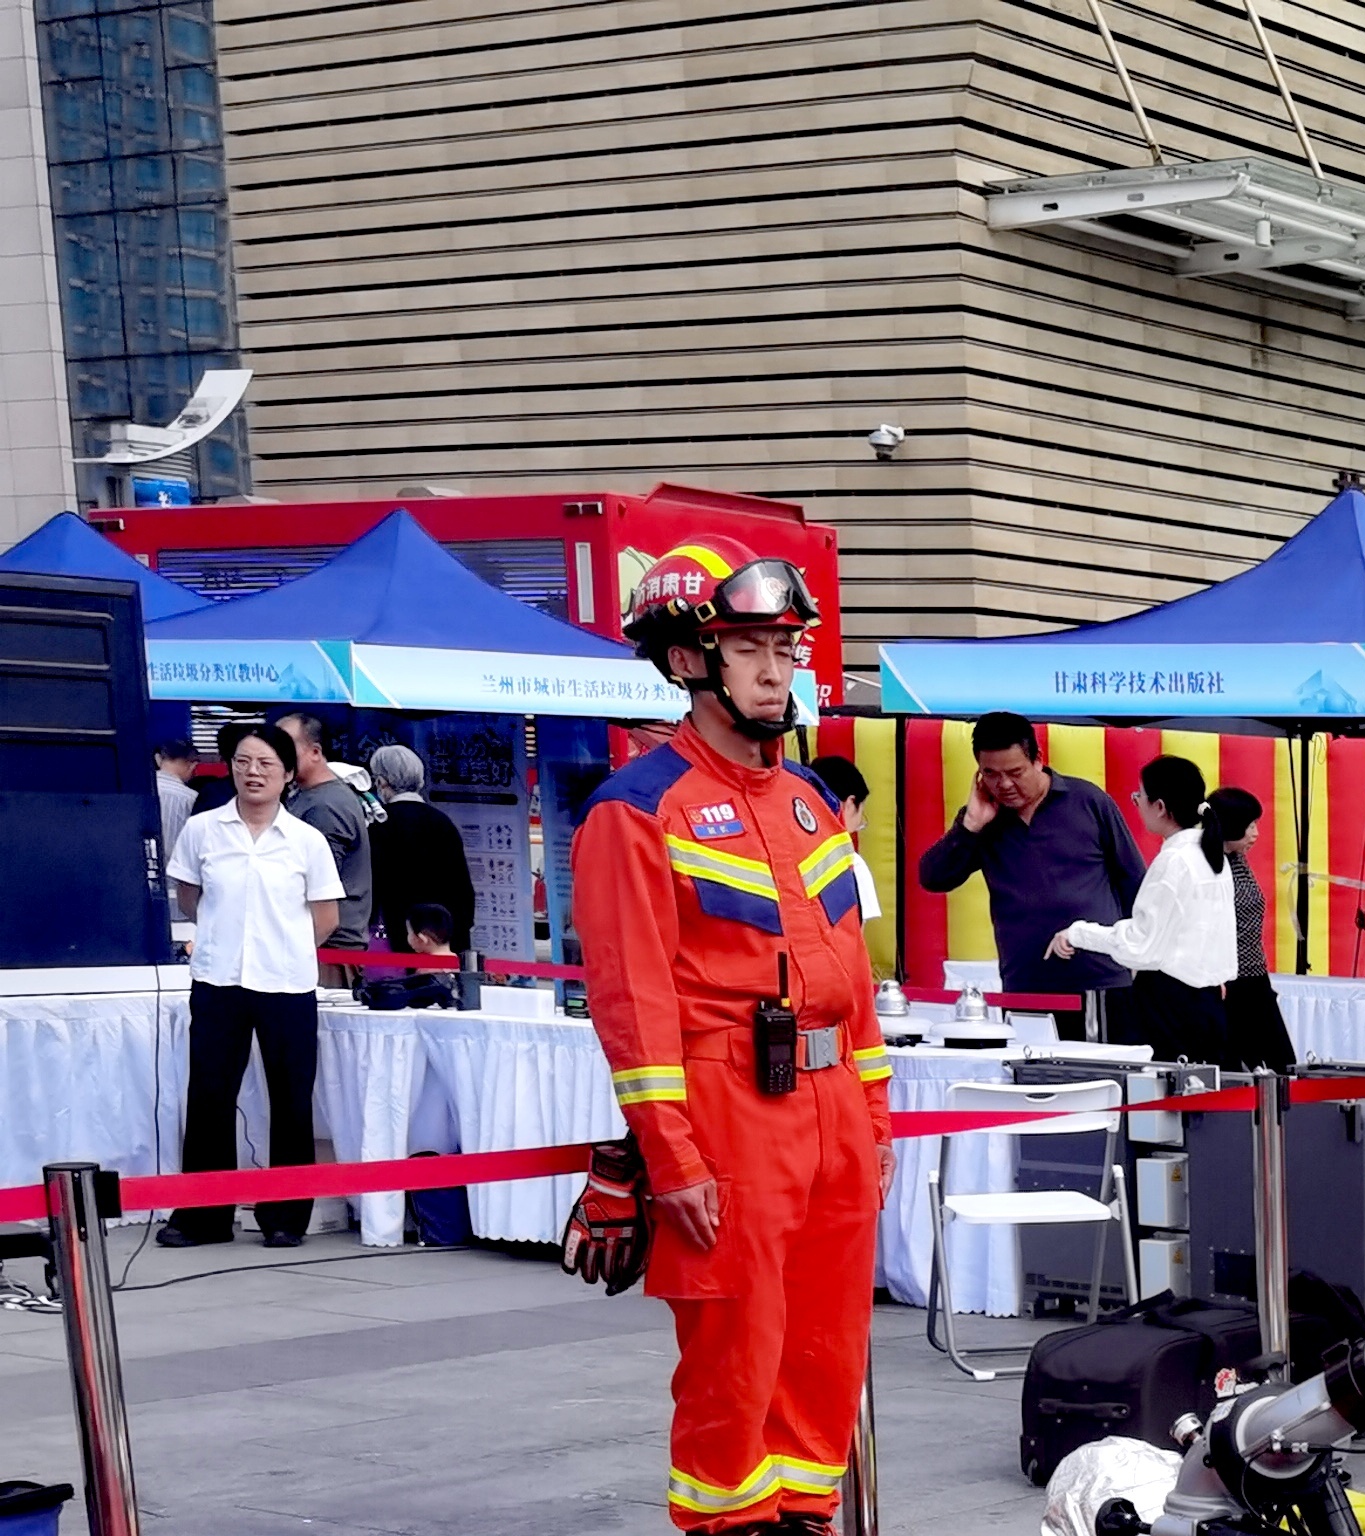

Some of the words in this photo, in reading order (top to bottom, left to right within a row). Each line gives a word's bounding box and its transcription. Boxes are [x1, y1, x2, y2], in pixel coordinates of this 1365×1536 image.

[1053, 671, 1225, 695] 甘肃科学技术出版社
[701, 803, 736, 823] 119
